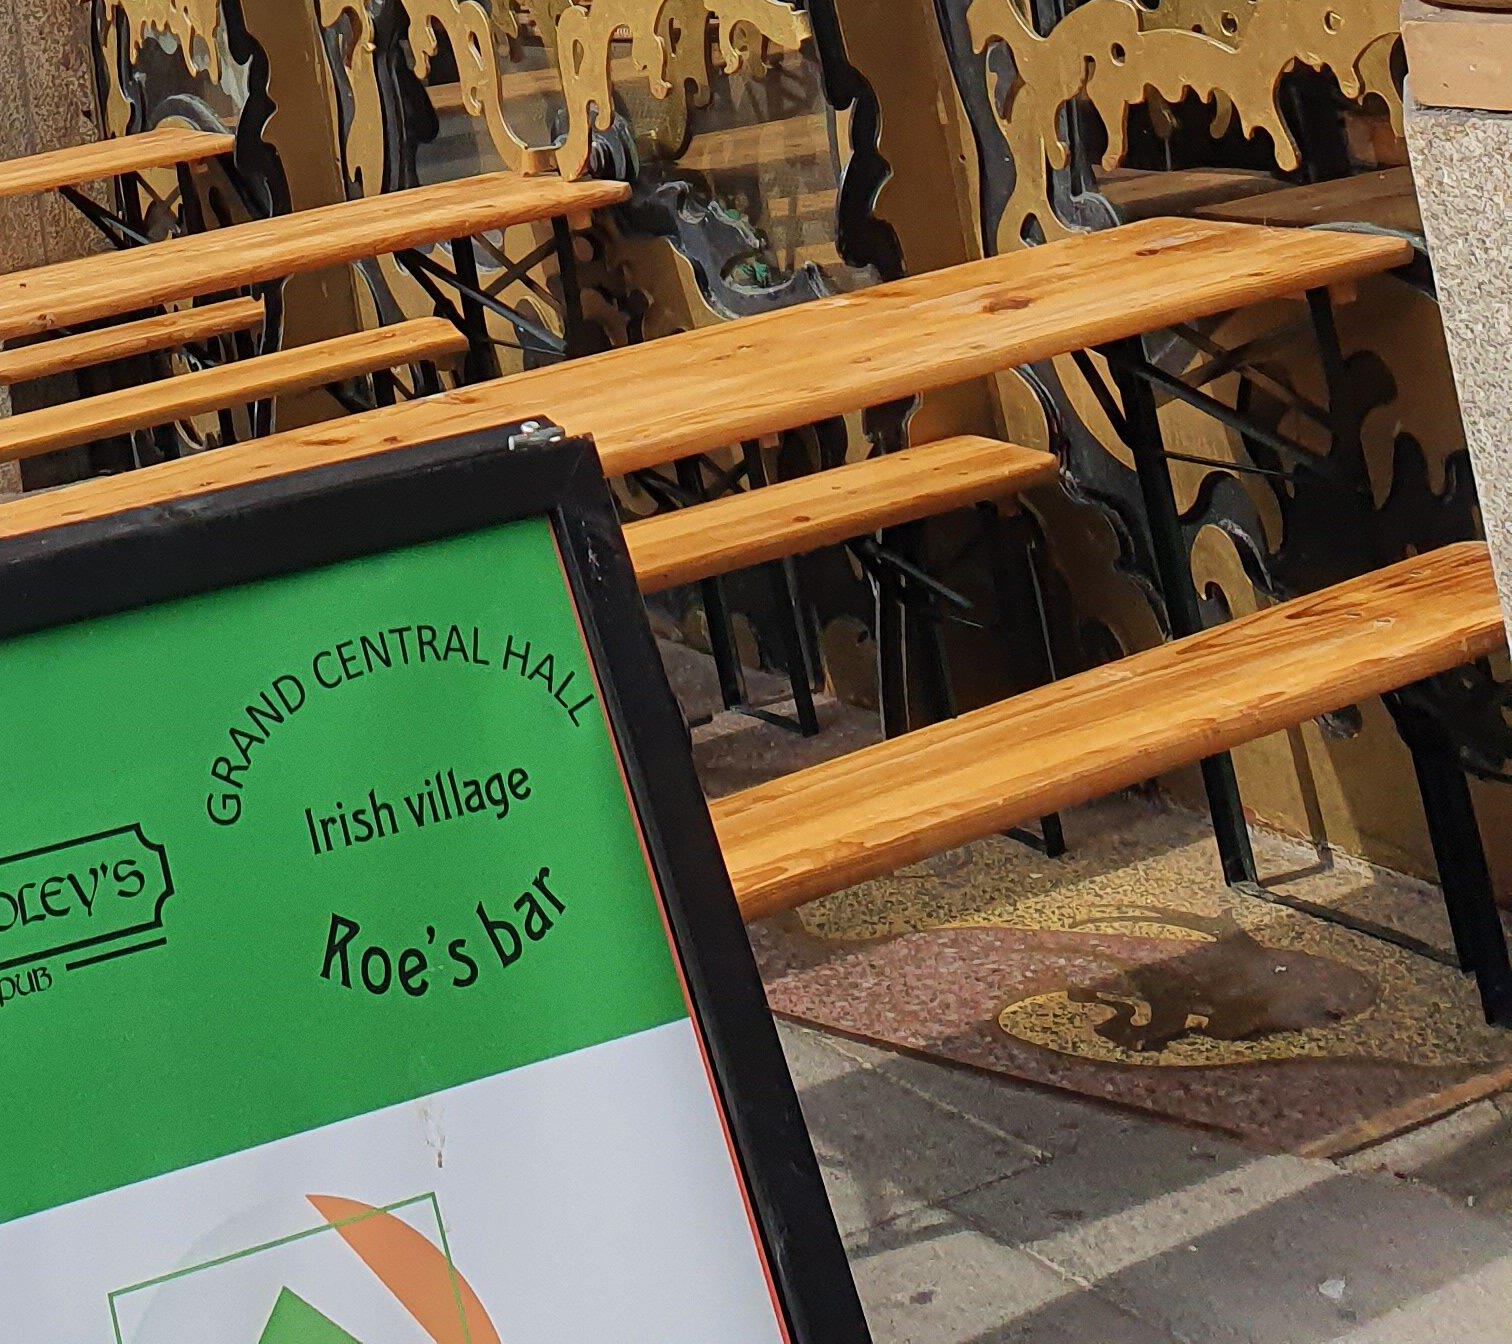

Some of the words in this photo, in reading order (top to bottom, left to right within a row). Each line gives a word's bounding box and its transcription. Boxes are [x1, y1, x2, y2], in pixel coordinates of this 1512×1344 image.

[206, 674, 307, 826] GRAND
[311, 624, 490, 689] CENTRAL
[502, 635, 596, 727] HALL
[304, 788, 399, 855] Irish
[403, 767, 533, 820] village
[319, 912, 479, 997] Roe's
[475, 866, 567, 969] bar
